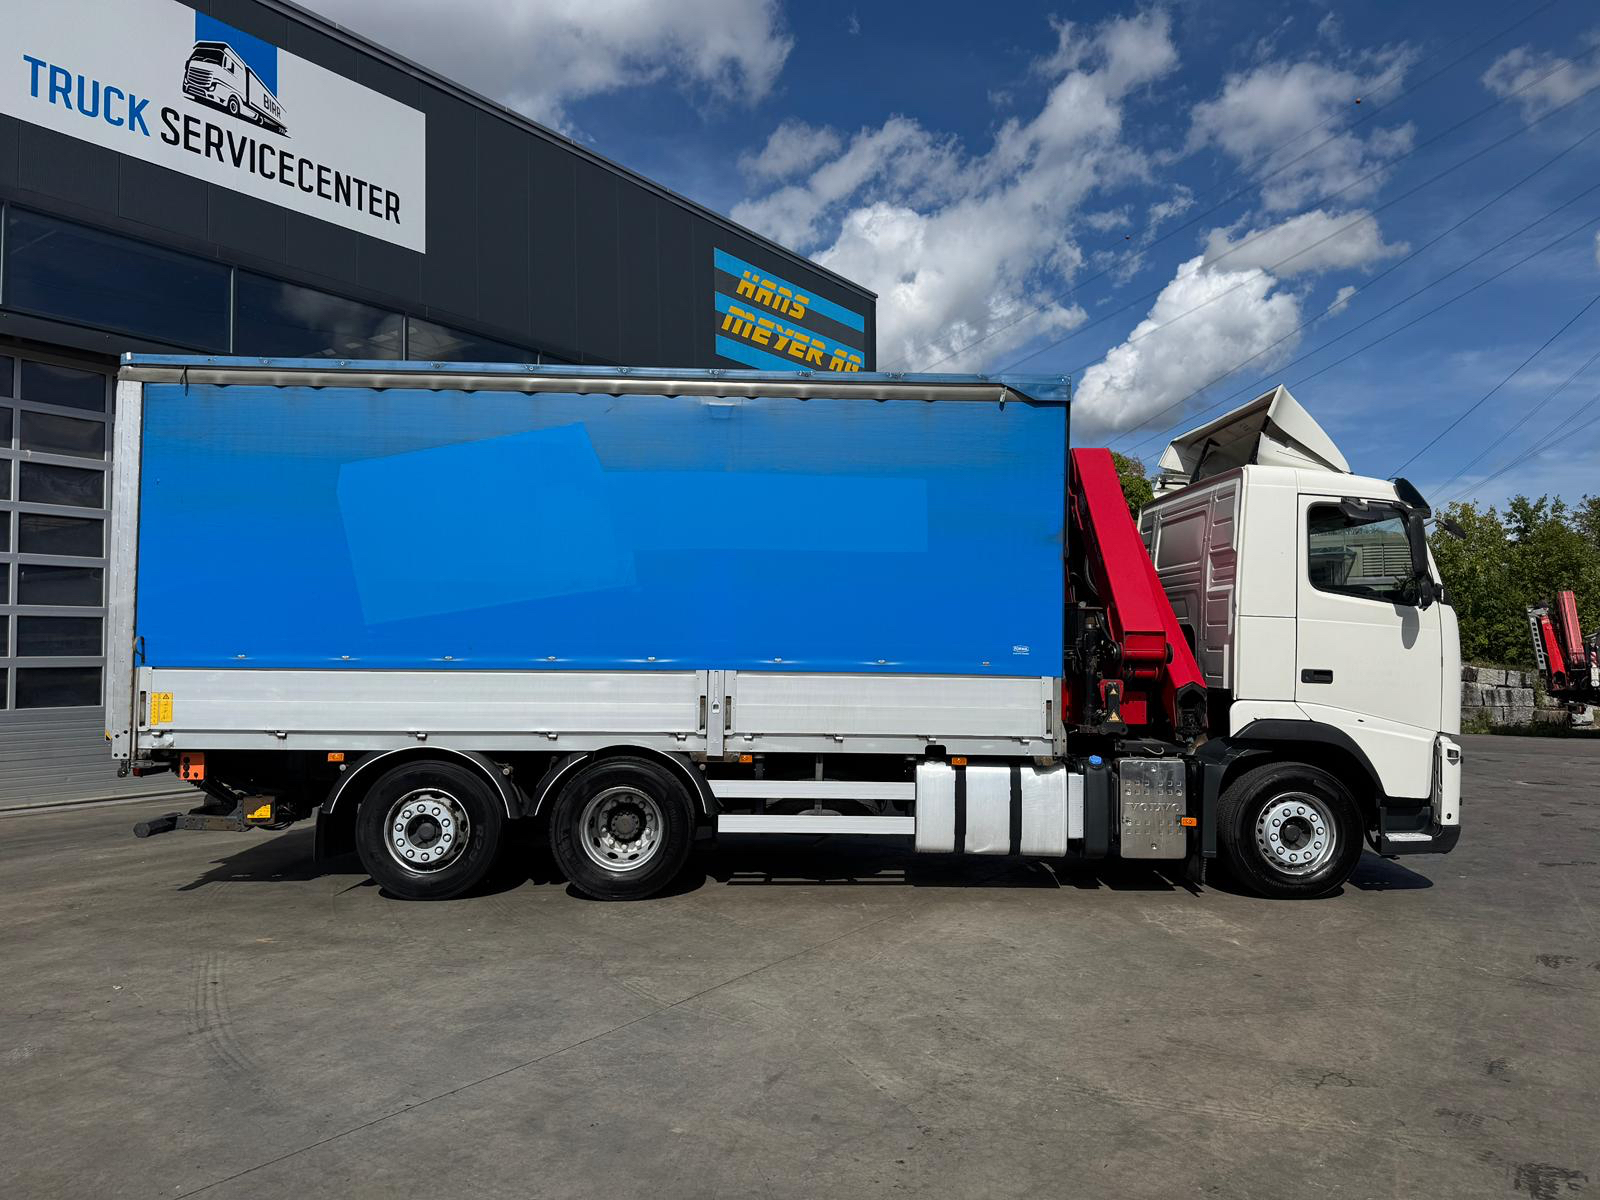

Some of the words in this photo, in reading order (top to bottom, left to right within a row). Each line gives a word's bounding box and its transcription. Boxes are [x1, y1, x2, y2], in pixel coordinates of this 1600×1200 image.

[263, 93, 281, 120] BIRR
[23, 54, 151, 137] TRUCK
[160, 106, 401, 225] SERVICECENTER
[736, 270, 810, 320] HANS
[721, 305, 826, 366] MEYER
[829, 348, 862, 373] AG
